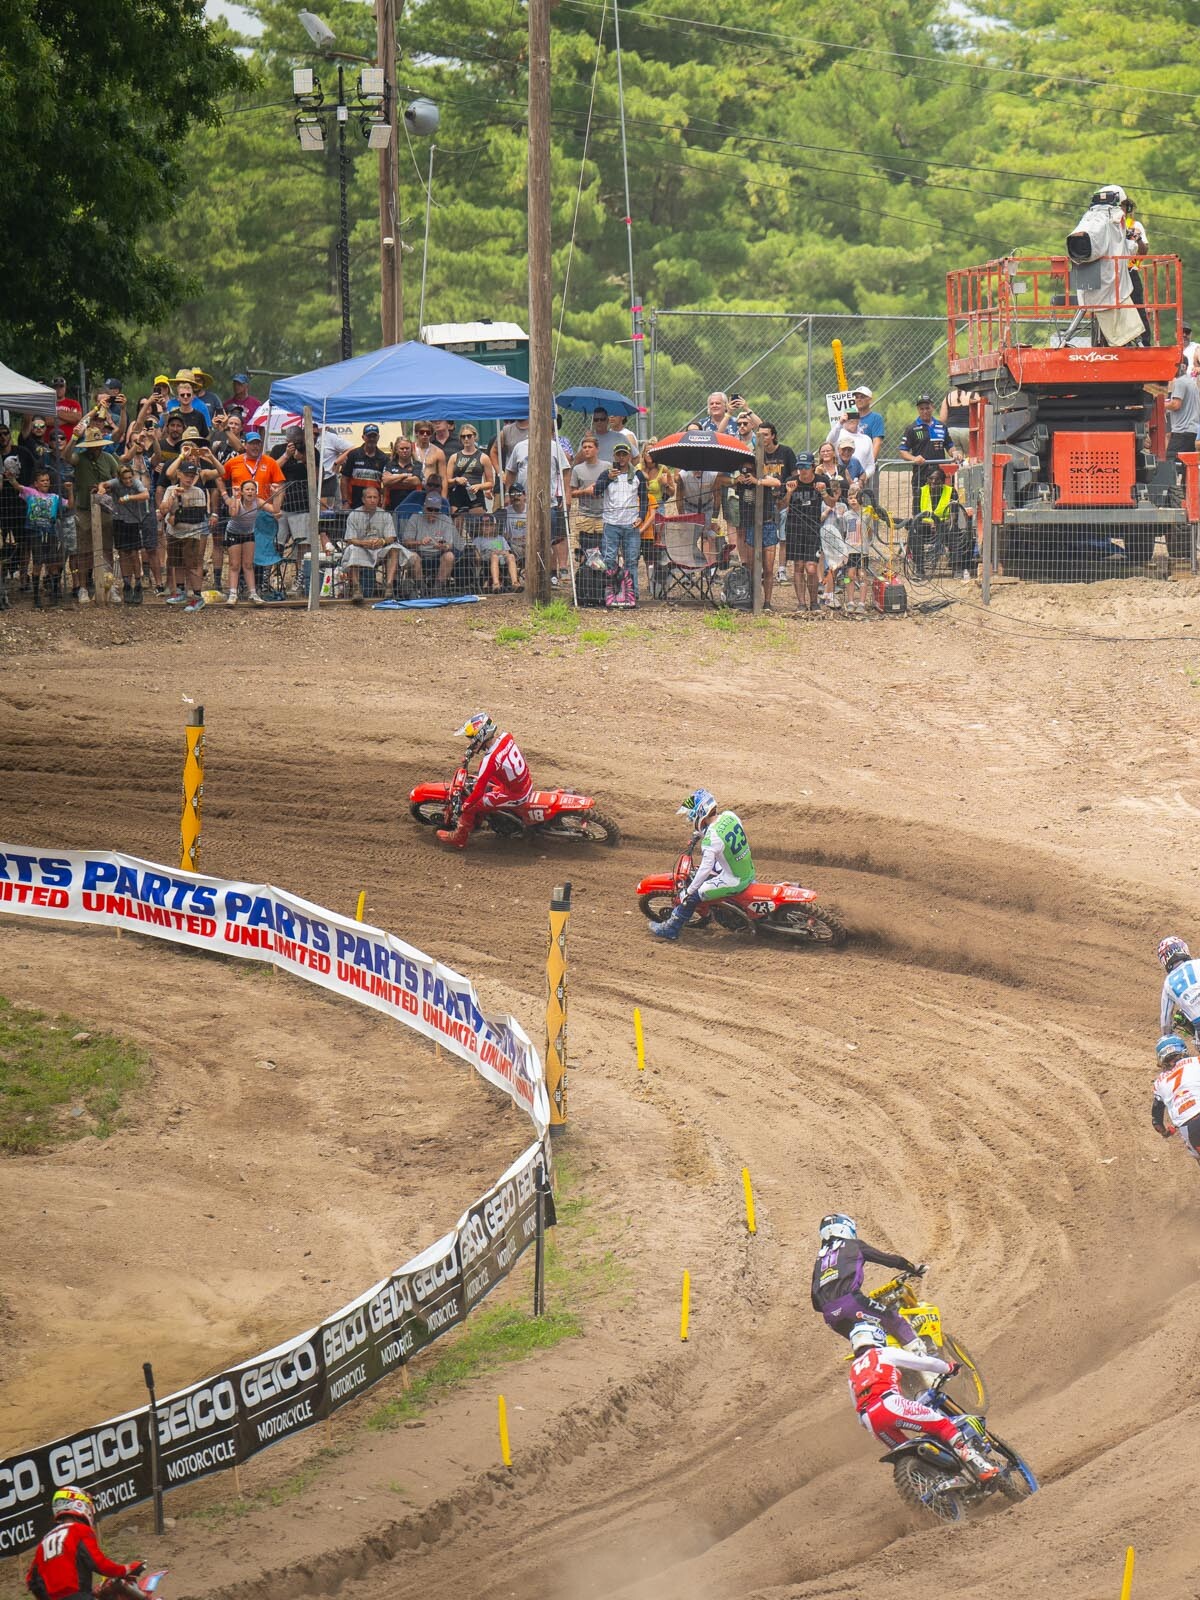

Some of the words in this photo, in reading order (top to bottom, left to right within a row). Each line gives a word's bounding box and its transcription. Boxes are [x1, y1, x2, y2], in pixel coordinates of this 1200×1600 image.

[1068, 351, 1120, 363] SKYJACK
[834, 399, 856, 412] VIP
[1069, 464, 1120, 476] SKYJACK
[502, 743, 527, 782] 18
[527, 809, 545, 822] 18
[724, 823, 747, 856] 23
[752, 902, 770, 915] 23
[82, 860, 218, 917] PARTS
[225, 891, 330, 953] PARTS
[335, 928, 419, 994] PARTS
[82, 892, 217, 938] UNLIMITED
[224, 922, 331, 975] UNLIMITED
[337, 959, 419, 1016] UNLIMITED
[1168, 963, 1197, 998] 81
[1166, 1067, 1185, 1093] 7
[50, 1419, 141, 1487] GEICO
[149, 1380, 237, 1446] GEICO
[240, 1341, 318, 1408] GEICO
[322, 1306, 367, 1367] GEICO
[368, 1276, 413, 1333] GEICO
[412, 1247, 458, 1303] GEICO
[484, 1180, 517, 1238] GEICO
[853, 1353, 871, 1376] 14
[167, 1439, 237, 1482] MOTORCYCLE
[256, 1400, 313, 1442] MOTORCYCLE
[329, 1363, 367, 1402] MOTORCYCLE
[380, 1329, 414, 1367] MOTORCYCLE
[426, 1298, 459, 1335] MOTORCYCLE
[41, 1528, 69, 1562] 107
